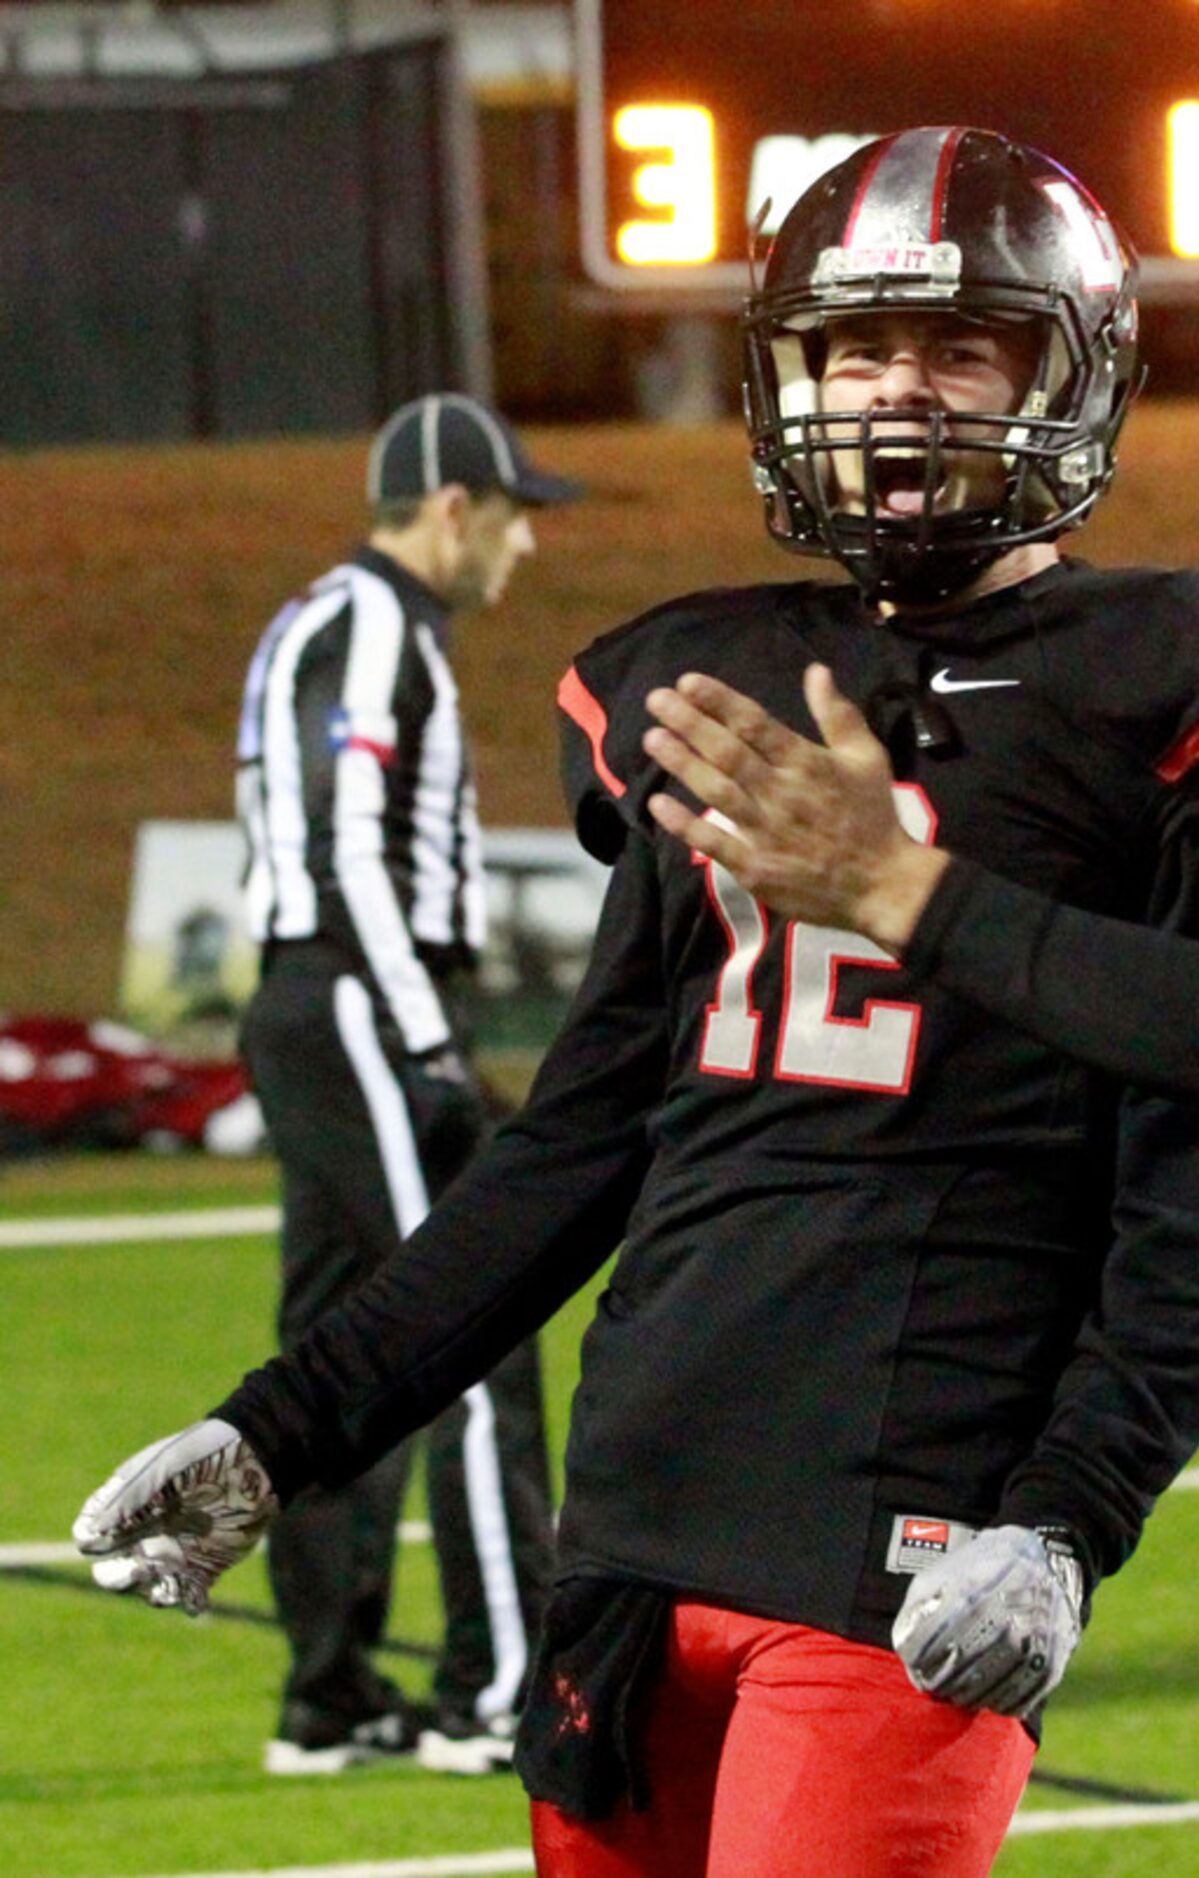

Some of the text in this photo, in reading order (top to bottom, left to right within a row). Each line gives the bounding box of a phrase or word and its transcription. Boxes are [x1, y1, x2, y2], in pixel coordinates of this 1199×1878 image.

[613, 103, 716, 265] 3
[903, 249, 926, 270] IT
[692, 782, 938, 1095] 12
